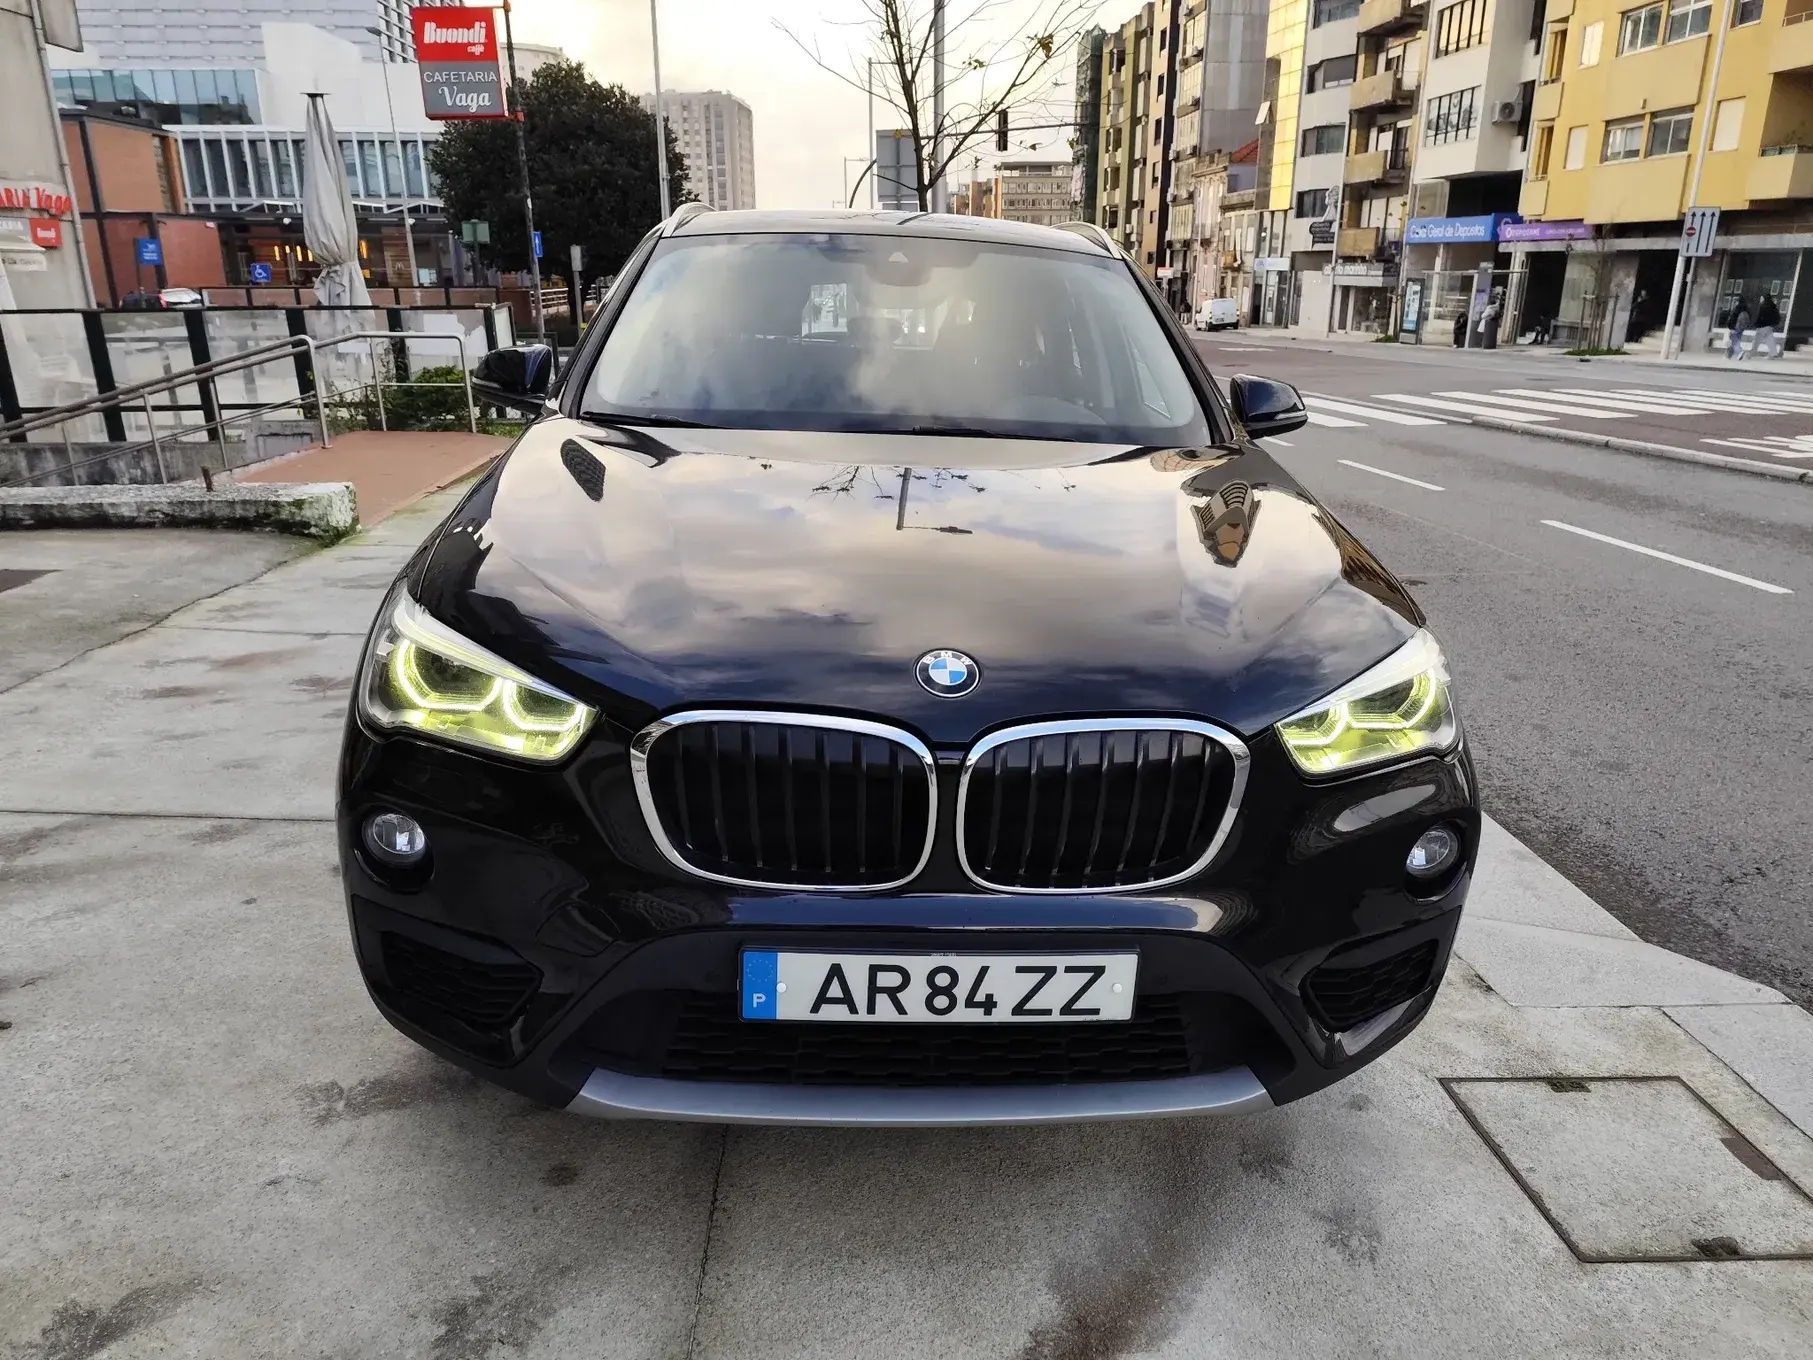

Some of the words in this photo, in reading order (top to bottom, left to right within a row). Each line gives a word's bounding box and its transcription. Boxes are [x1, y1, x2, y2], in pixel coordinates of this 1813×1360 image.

[423, 21, 487, 44] Buondi
[423, 71, 498, 83] CAFETARIA
[438, 85, 492, 113] Vaga
[1427, 223, 1445, 238] Geral
[1444, 225, 1454, 237] de
[921, 651, 974, 666] BMW
[752, 992, 767, 1009] P
